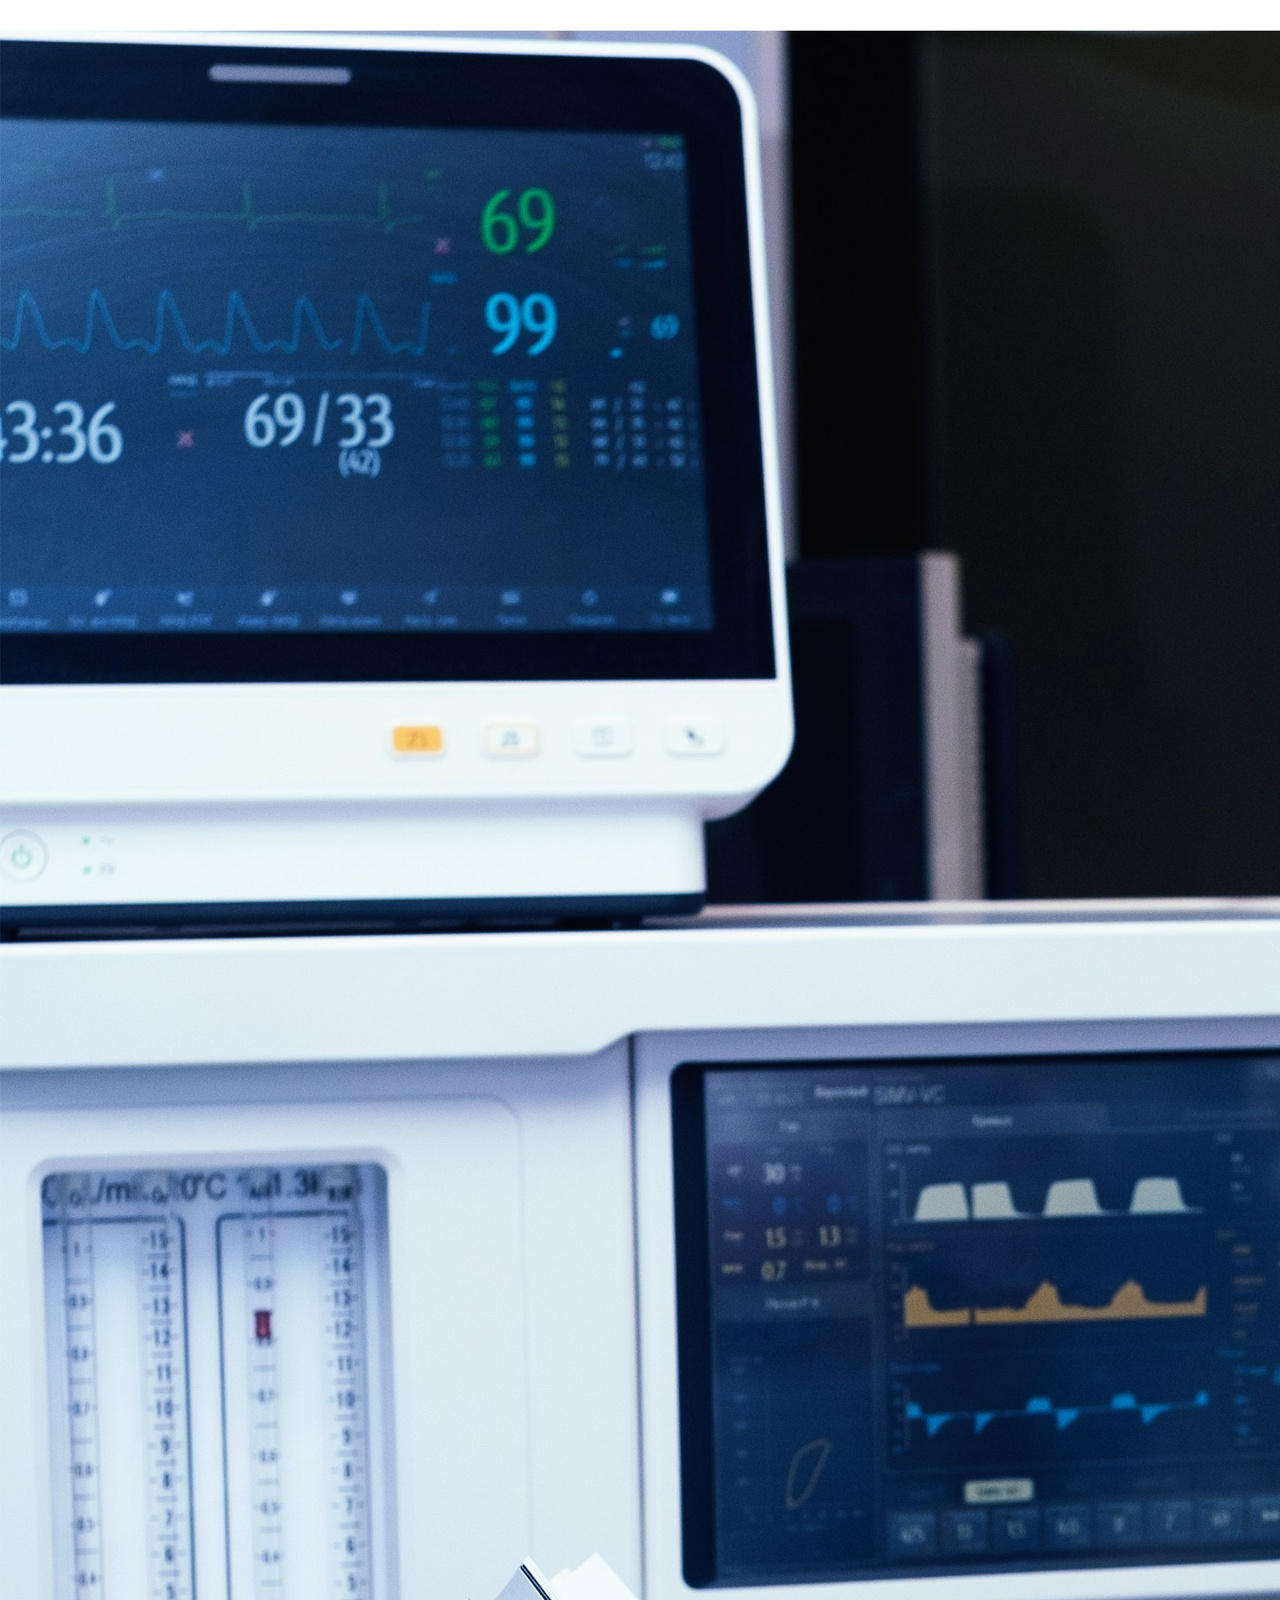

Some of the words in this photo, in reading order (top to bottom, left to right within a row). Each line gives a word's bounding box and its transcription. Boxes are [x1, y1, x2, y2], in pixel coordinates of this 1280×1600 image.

[480, 185, 556, 255] 69
[483, 290, 558, 356] 99
[0, 399, 124, 465] 3:36
